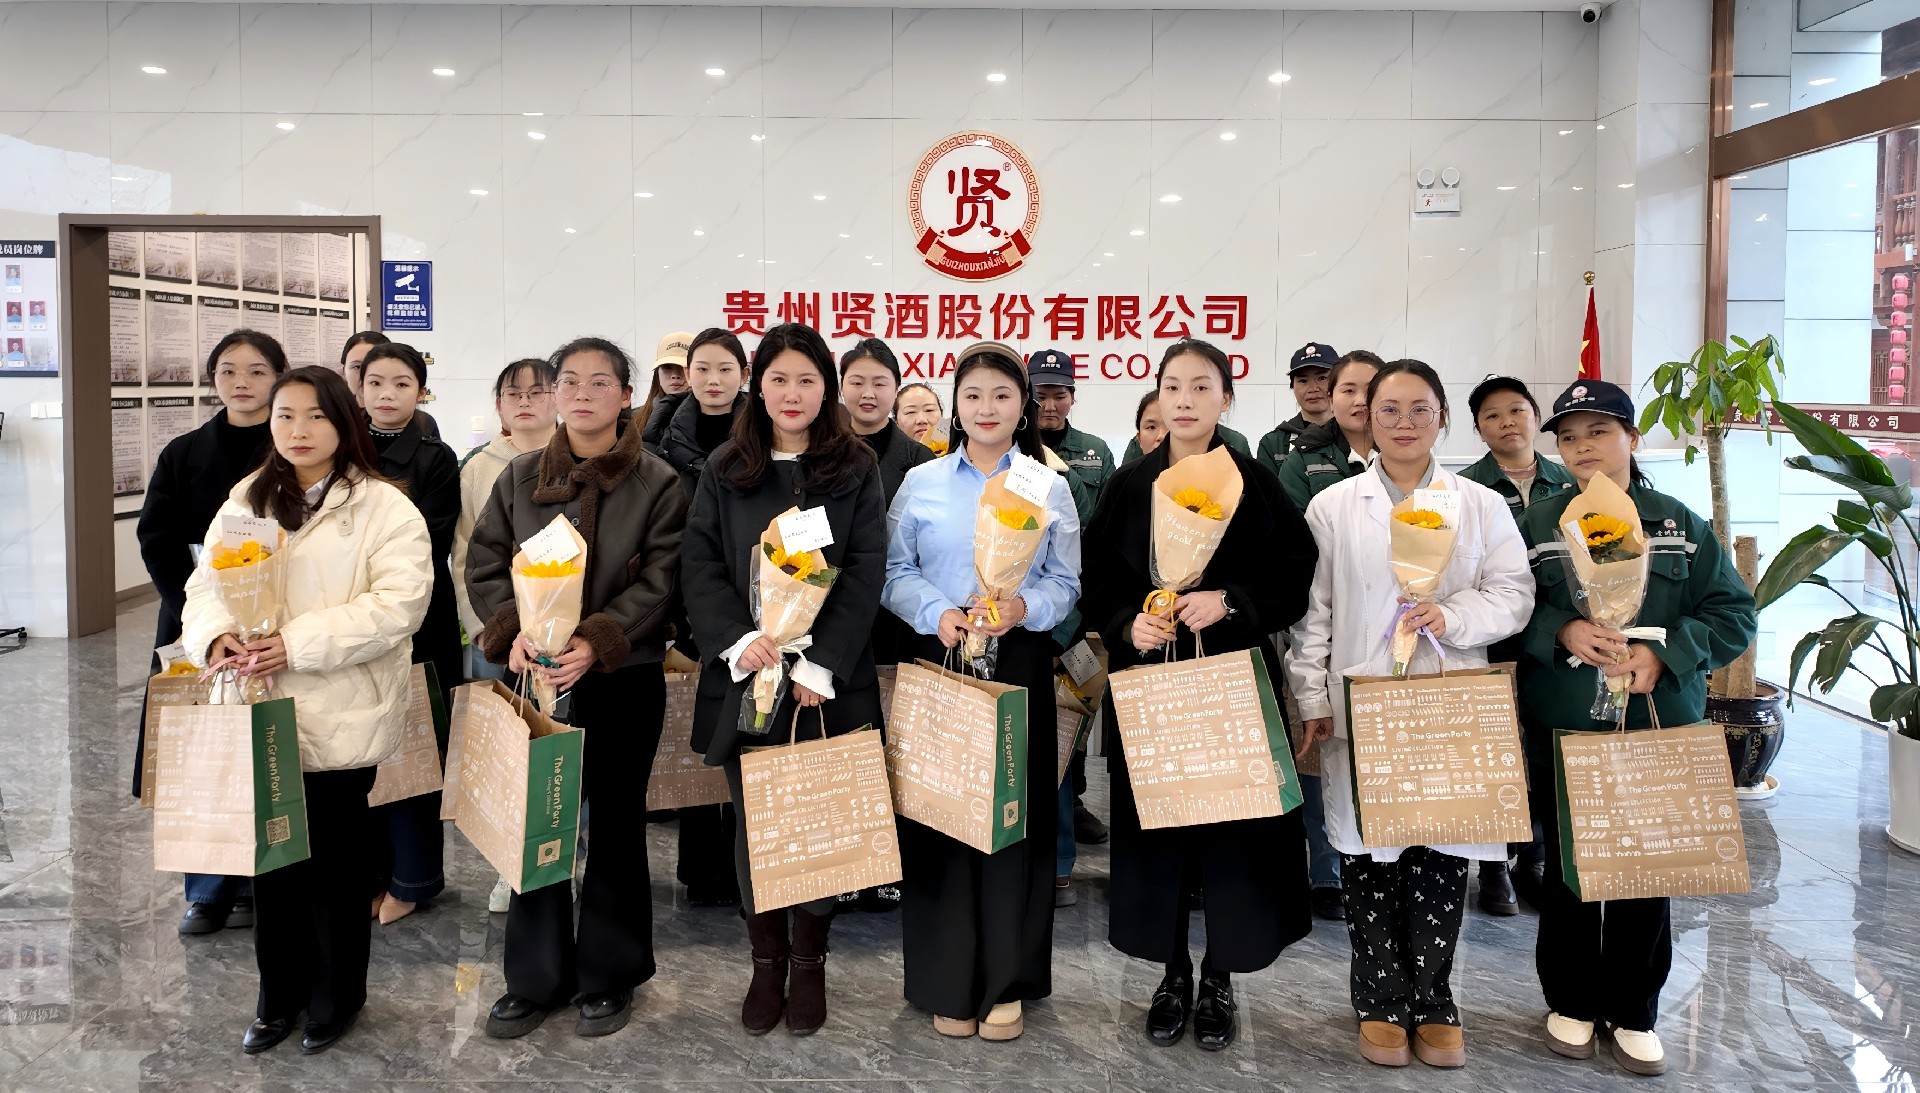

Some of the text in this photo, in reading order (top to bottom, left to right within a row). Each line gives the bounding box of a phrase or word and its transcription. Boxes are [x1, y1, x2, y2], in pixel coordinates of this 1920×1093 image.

[947, 166, 1011, 237] 贤
[939, 255, 1007, 272] GUIZHOUXIANJIU
[722, 289, 1249, 341] 贵州贤酒股份有限公司
[998, 535, 1026, 551] bring
